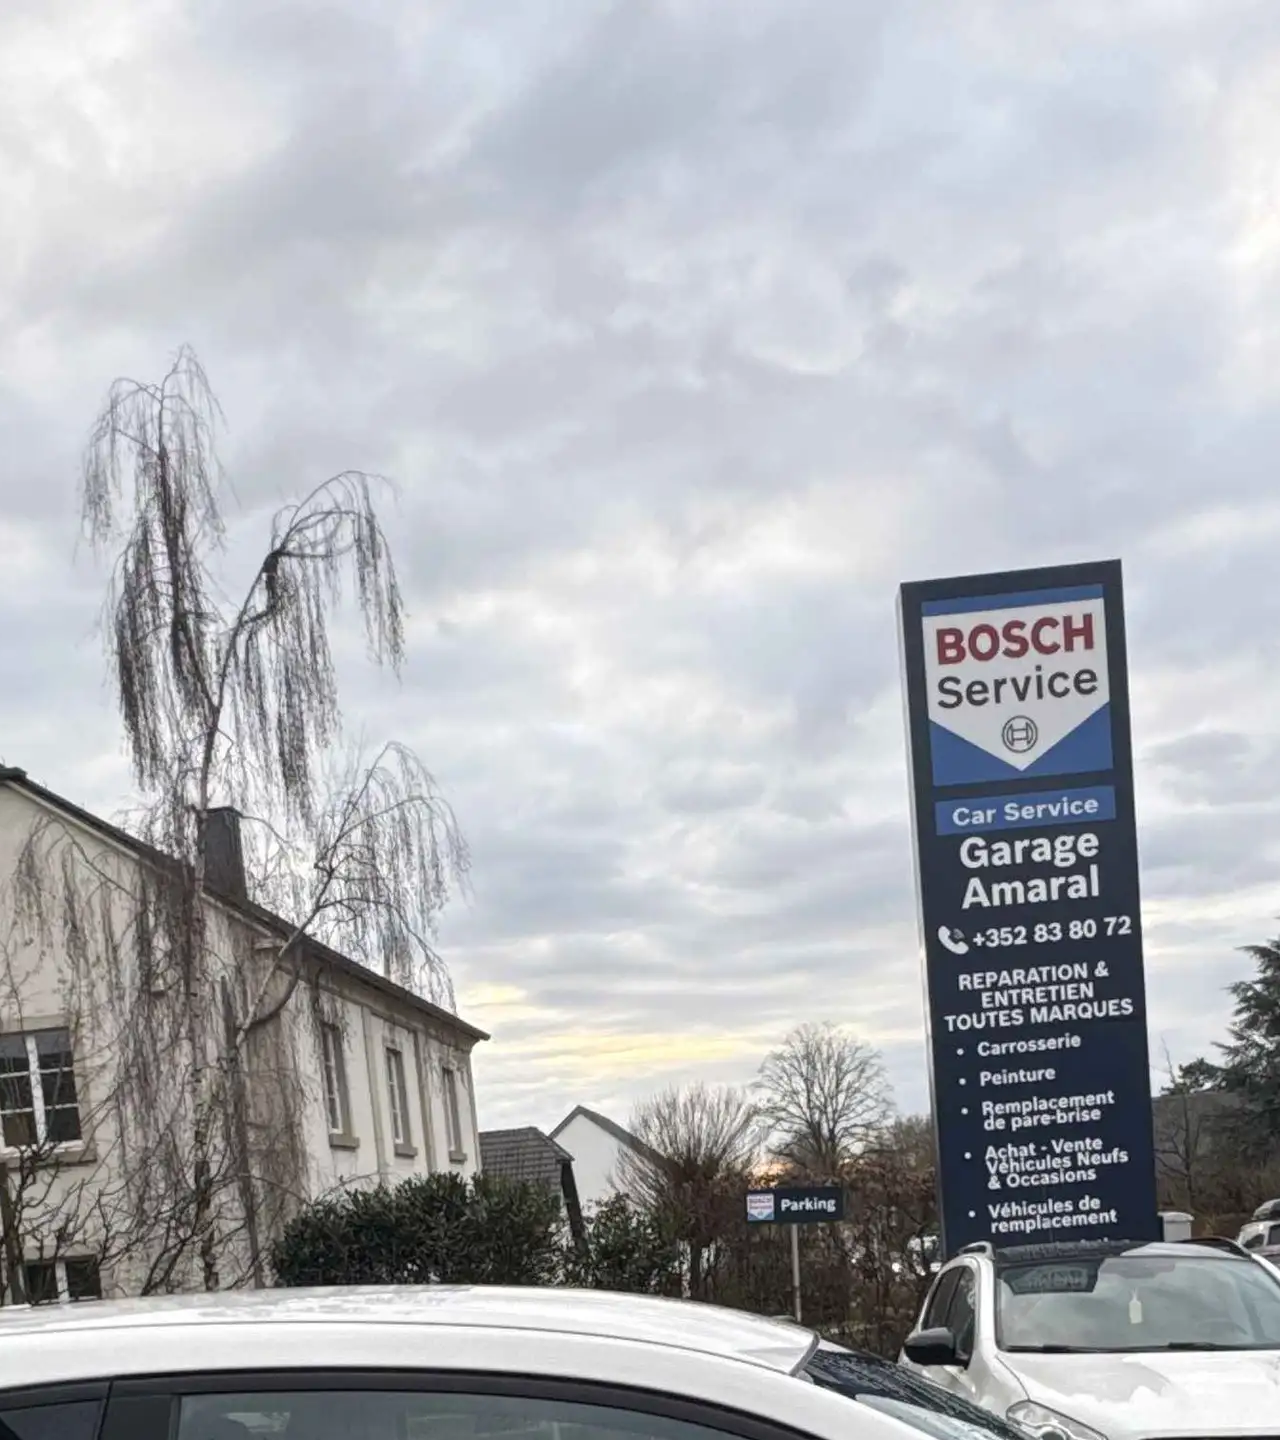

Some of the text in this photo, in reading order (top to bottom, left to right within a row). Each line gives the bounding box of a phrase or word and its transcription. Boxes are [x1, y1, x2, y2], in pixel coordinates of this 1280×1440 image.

[936, 613, 1095, 665] BOSCH
[937, 665, 1098, 709] Service
[952, 797, 1099, 826] Car Service
[960, 832, 1100, 869] Garage
[961, 864, 1100, 910] Amaral
[972, 915, 1132, 948] +352 83 80 72
[958, 960, 1109, 990] REPARATION &
[981, 982, 1094, 1009] ENTRETIEN
[944, 998, 1134, 1032] TOUTES MARQUES
[977, 1033, 1081, 1057] Carrosserie
[980, 1067, 1056, 1087] Peinture
[982, 1090, 1115, 1117] Remplacement
[984, 1107, 1101, 1131] de pare-brise
[985, 1141, 1036, 1160] Achat
[1052, 1137, 1103, 1153] Vente
[986, 1148, 1129, 1174] Véhicules Neufs
[988, 1168, 1096, 1190] & Occasions
[780, 1197, 836, 1212] Parking
[988, 1195, 1101, 1219] Véhicules de
[991, 1209, 1118, 1234] remplacement
